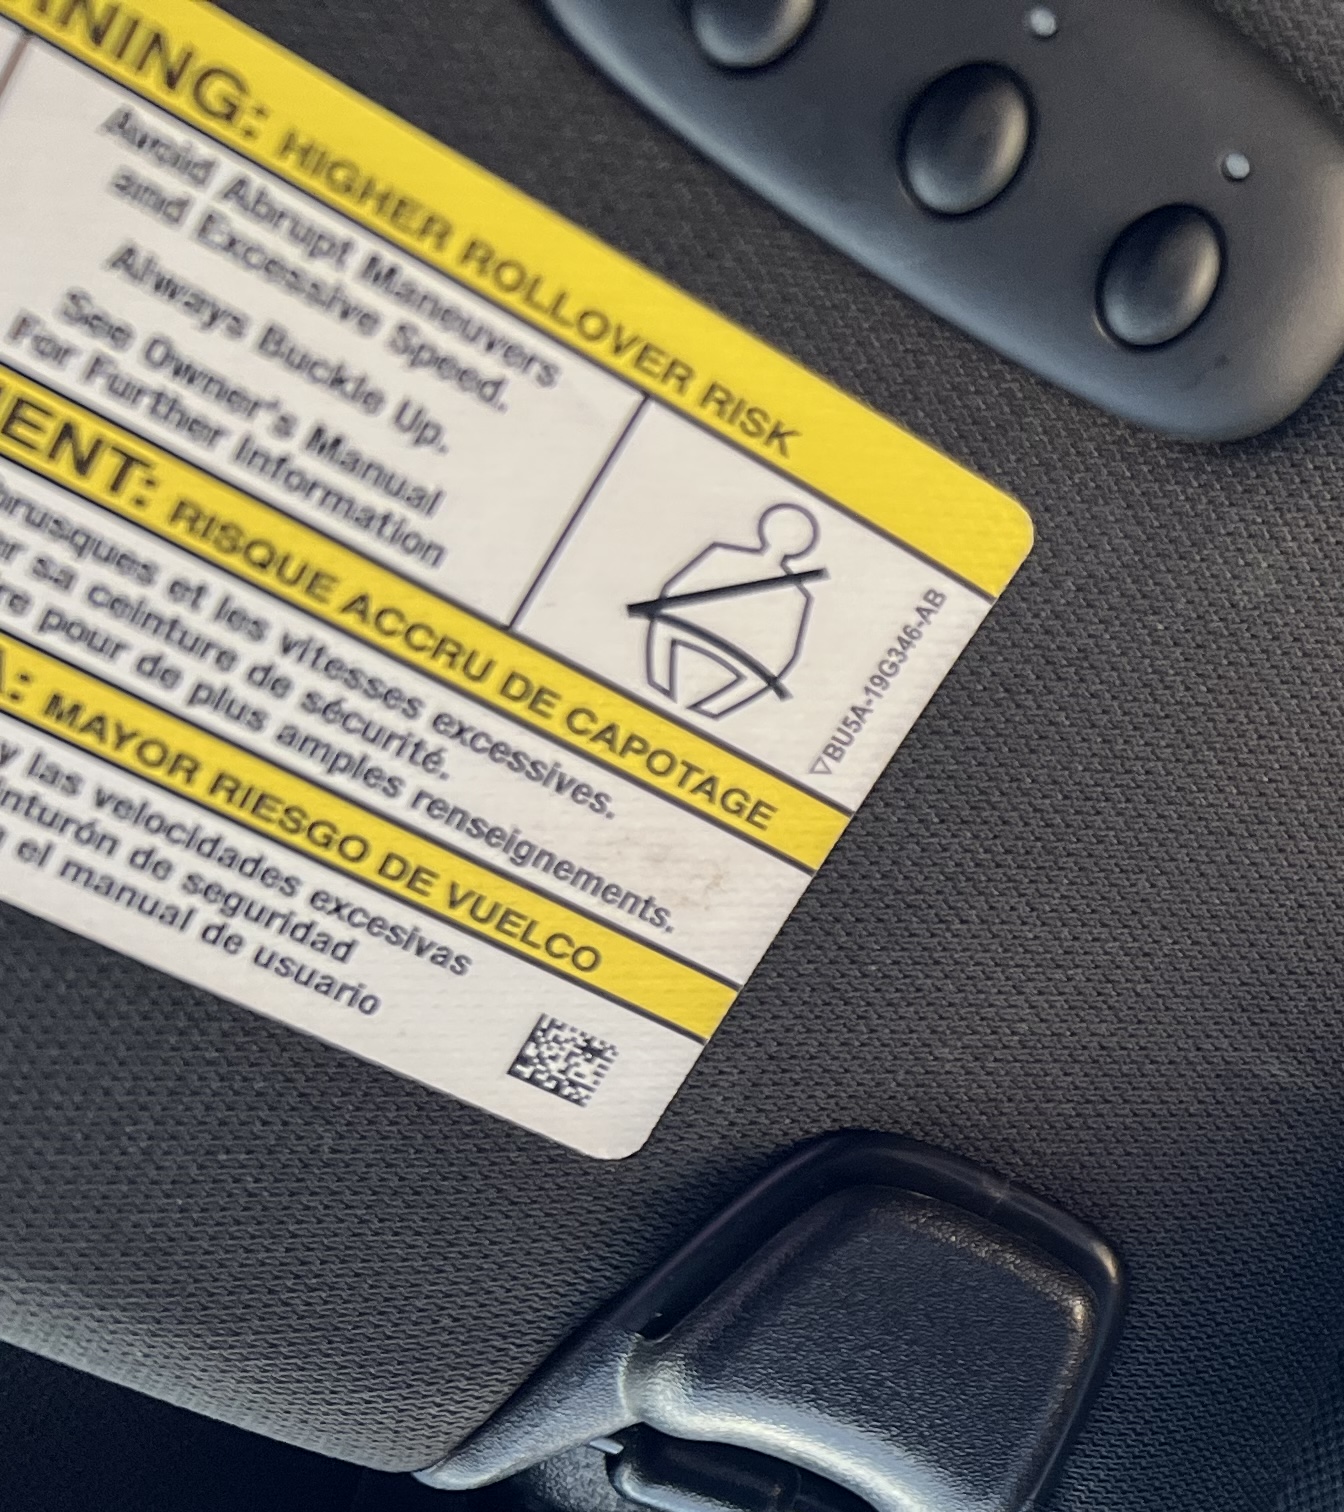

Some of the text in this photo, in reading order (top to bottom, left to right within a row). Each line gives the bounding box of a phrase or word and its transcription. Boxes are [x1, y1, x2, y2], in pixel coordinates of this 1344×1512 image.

[35, 0, 800, 459] NING: HIGHER ROLLOVER RISK
[101, 108, 559, 388] Avoid Abrupt Maneuvers
[108, 170, 508, 412] and Excessive Speed.
[111, 244, 449, 452] Always Buckle Up.
[12, 315, 445, 567] For Further Information
[61, 288, 444, 516] See Owner's Manual
[0, 388, 779, 831] ENT: RISQUE ACCRU DE CAPOTAGE
[0, 490, 615, 820] rusques et les vitesses excessives.
[32, 556, 76, 590] sa
[88, 585, 238, 671] ceinture
[246, 662, 294, 702] de
[302, 687, 452, 781] sécurité.
[0, 790, 358, 963] nturón de seguridad
[28, 752, 82, 795] las
[96, 788, 301, 899] velocidades
[310, 888, 473, 978] excesivas
[38, 608, 676, 934] pour de plus amples renseignements.
[45, 694, 603, 974] MAYOR RIESGO DE VUELCO
[16, 843, 382, 1016] el manual de usuario
